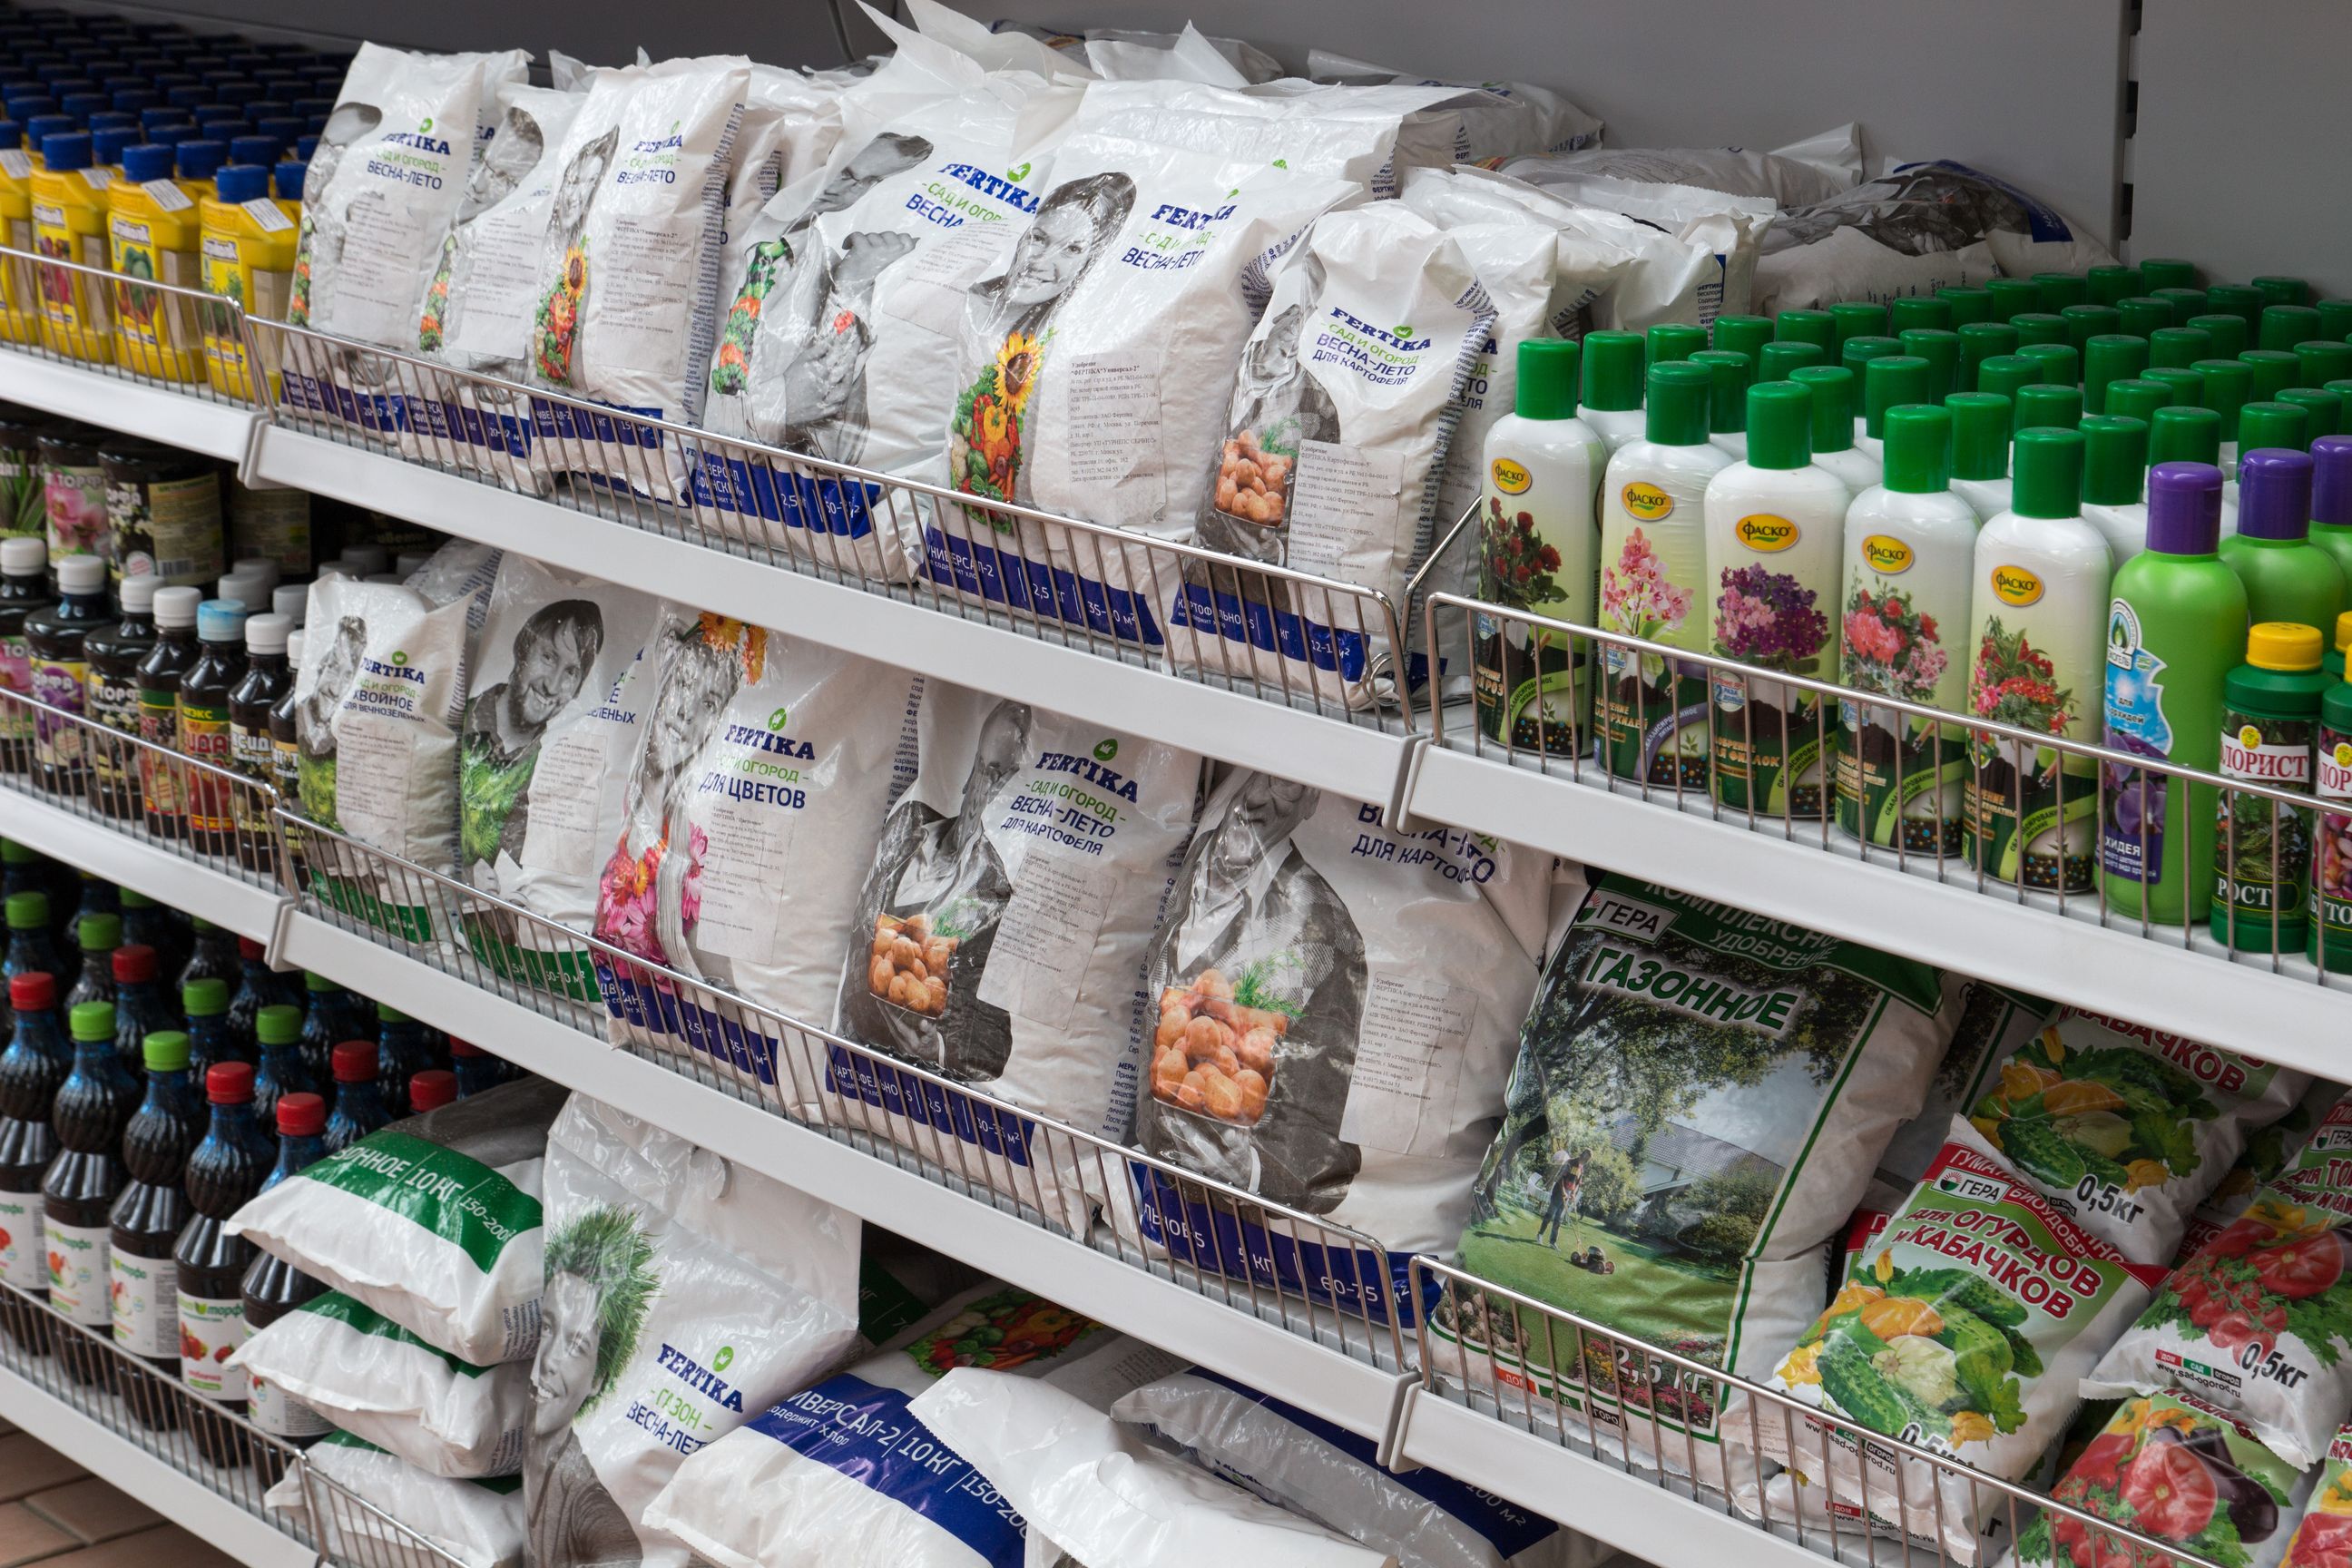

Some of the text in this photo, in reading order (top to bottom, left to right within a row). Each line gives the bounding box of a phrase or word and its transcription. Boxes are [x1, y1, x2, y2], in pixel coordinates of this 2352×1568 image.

[367, 161, 443, 190] ВЕСНА-ЛЕТО
[402, 155, 440, 173] ОГОРОД
[928, 182, 953, 206] САД
[956, 199, 969, 210] И
[937, 163, 1040, 214] FERTIKA
[906, 193, 965, 229] ВЕСНА
[1329, 323, 1419, 366] САД И ОГОРОД
[1330, 307, 1431, 351] FERTIKA
[1312, 349, 1408, 387] ДЛЯ КАРТОФЕЛЯ
[1316, 333, 1416, 377] ВЕСНА-ЛЕТО
[1495, 463, 1524, 484] ФАСКО
[1628, 488, 1664, 508] ФАСКО
[1742, 521, 1789, 543] ФАСКО
[1867, 543, 1905, 561] ФАСКО
[1033, 583, 1049, 600] 2,5
[1996, 572, 2034, 592] ФАСКО
[353, 690, 414, 711] ХВОЙНОЕ
[742, 760, 799, 783] ОГОРОД
[1035, 751, 1139, 803] FERTIKA
[729, 778, 806, 809] ЦВЕТОВ
[1031, 780, 1118, 822] САД И ОГОРОД
[1010, 795, 1115, 838] ВЕСНА-ЛЕТО
[1001, 817, 1103, 857] ДЛЯ КАРТОФЕЛЯ
[1351, 834, 1396, 861] ДЛЯ
[1597, 899, 1661, 936] ГЕРА
[1585, 946, 1800, 1032] ГАЗОННОЕ
[405, 1168, 436, 1190] 10
[1959, 1180, 2001, 1200] ГЕРА
[1906, 1208, 2102, 1298] для ОГУРЦОВ
[1892, 1224, 2076, 1320] и КАБАЧКОВ
[656, 1343, 744, 1414] FERTIKA
[2156, 1361, 2241, 1399] www.sad-ogorod.ru
[626, 1400, 710, 1455] ВЕСНА-ЛЕТ
[655, 1387, 704, 1431] ГАЗОН
[787, 1389, 901, 1447] ИВЕРСАЛ-2
[898, 1436, 931, 1463] 10
[926, 1451, 963, 1477] КГ
[818, 1425, 850, 1447] хлор
